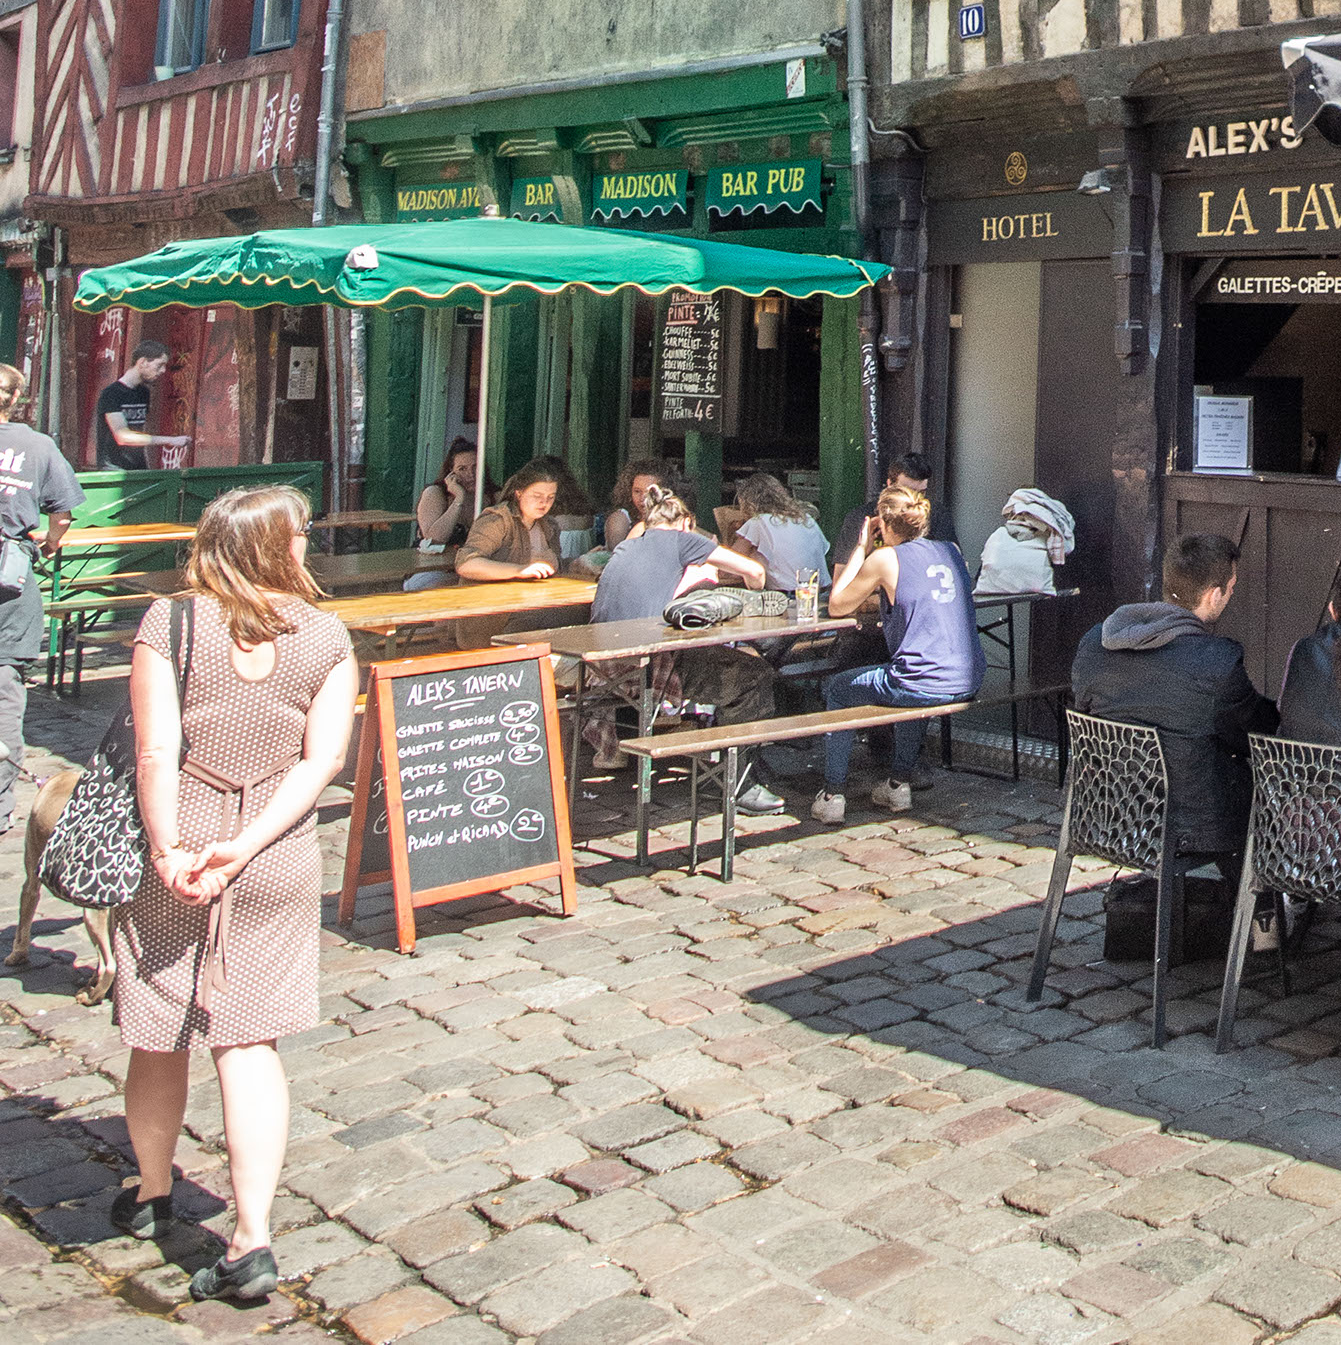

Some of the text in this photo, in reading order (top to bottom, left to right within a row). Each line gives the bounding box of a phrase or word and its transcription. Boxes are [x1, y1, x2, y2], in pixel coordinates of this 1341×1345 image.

[962, 8, 980, 35] 10
[1186, 117, 1304, 159] ALEX'S
[525, 182, 553, 206] BAR
[601, 173, 677, 200] MADISON
[721, 167, 805, 198] BAR PUB
[398, 190, 456, 212] MADISON
[1196, 187, 1259, 238] LA
[981, 211, 1059, 242] HOTEL
[926, 564, 956, 603] 3
[406, 670, 523, 706] ALEX'S TAVERN
[396, 721, 444, 738] GALETTE
[398, 740, 445, 758] GALETTE
[450, 732, 501, 750] COMPLETE
[400, 762, 448, 782] FRITES
[454, 749, 505, 771] MAISON
[402, 780, 447, 800] CAFÉ
[407, 803, 463, 825] PINTE
[407, 830, 443, 853] PUNCH
[447, 831, 460, 844] et
